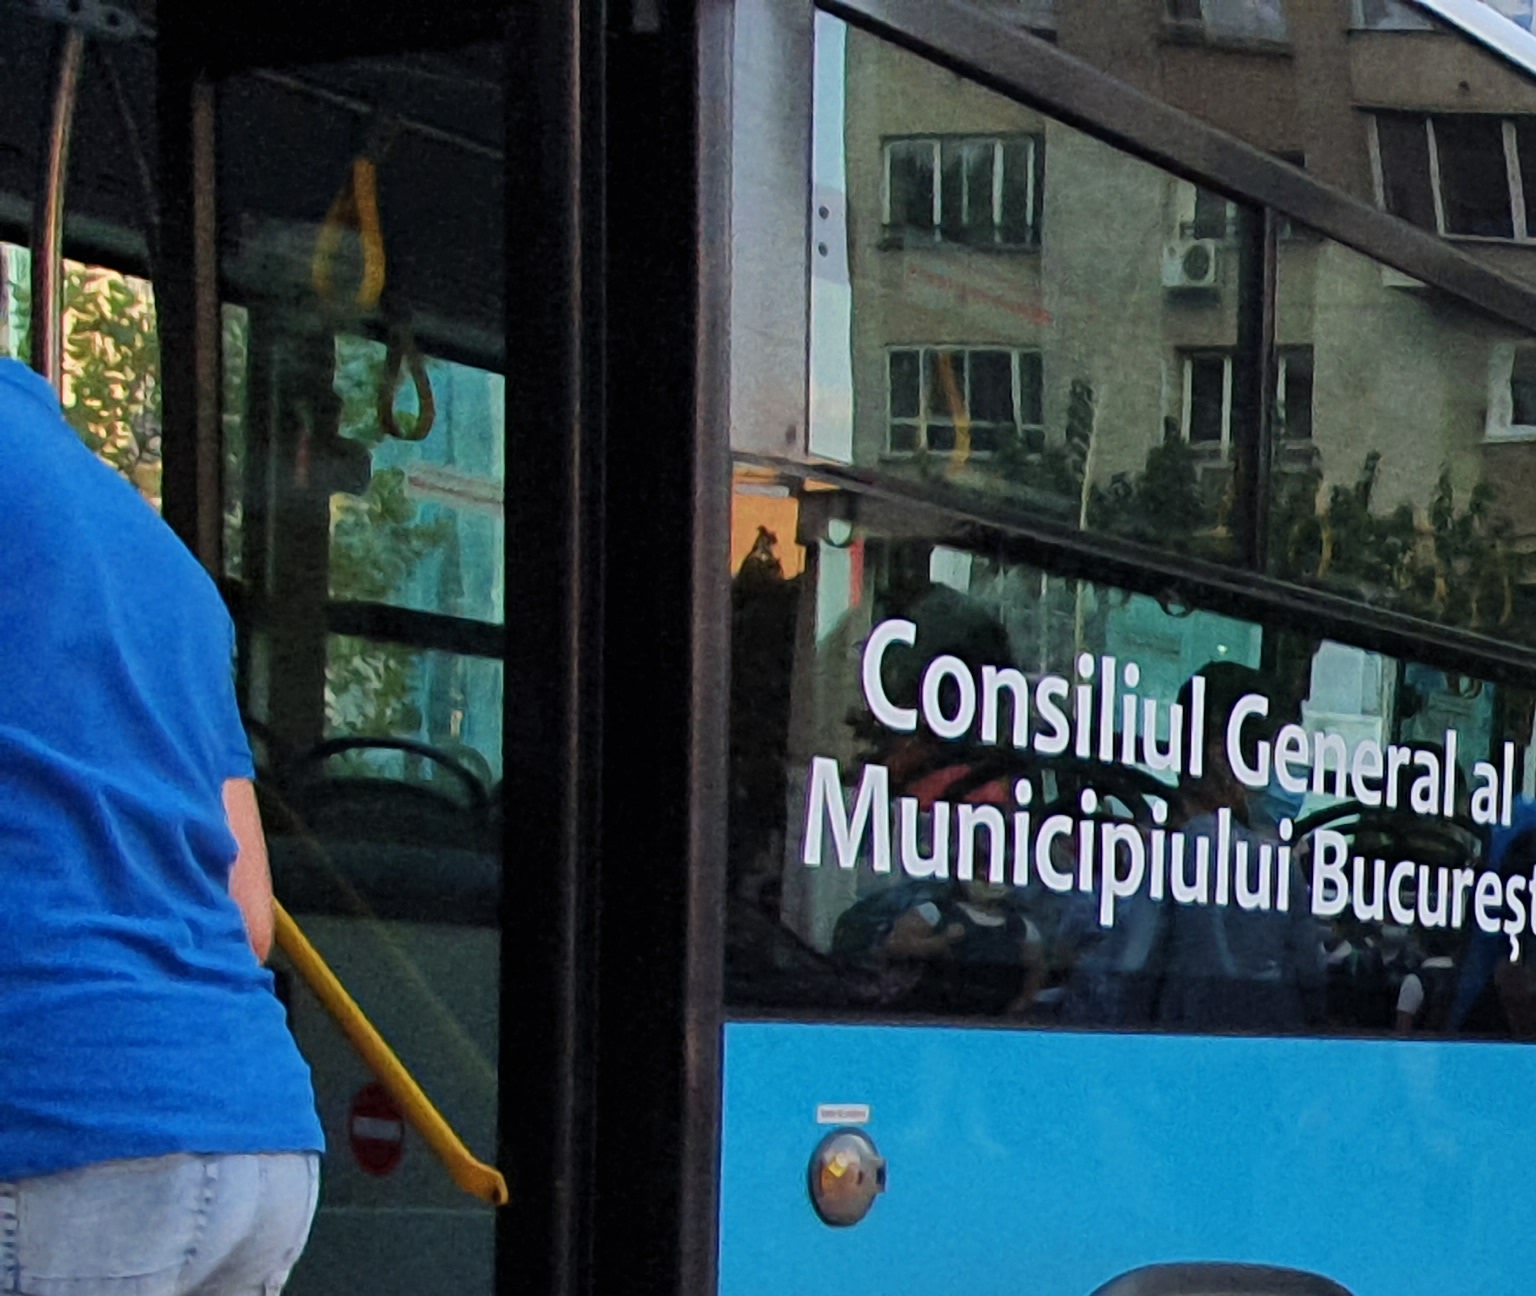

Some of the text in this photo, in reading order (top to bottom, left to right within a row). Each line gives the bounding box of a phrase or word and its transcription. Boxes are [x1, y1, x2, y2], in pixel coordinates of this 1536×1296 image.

[862, 618, 1515, 827] Consiliul General al
[803, 756, 1294, 927] Municipiului
